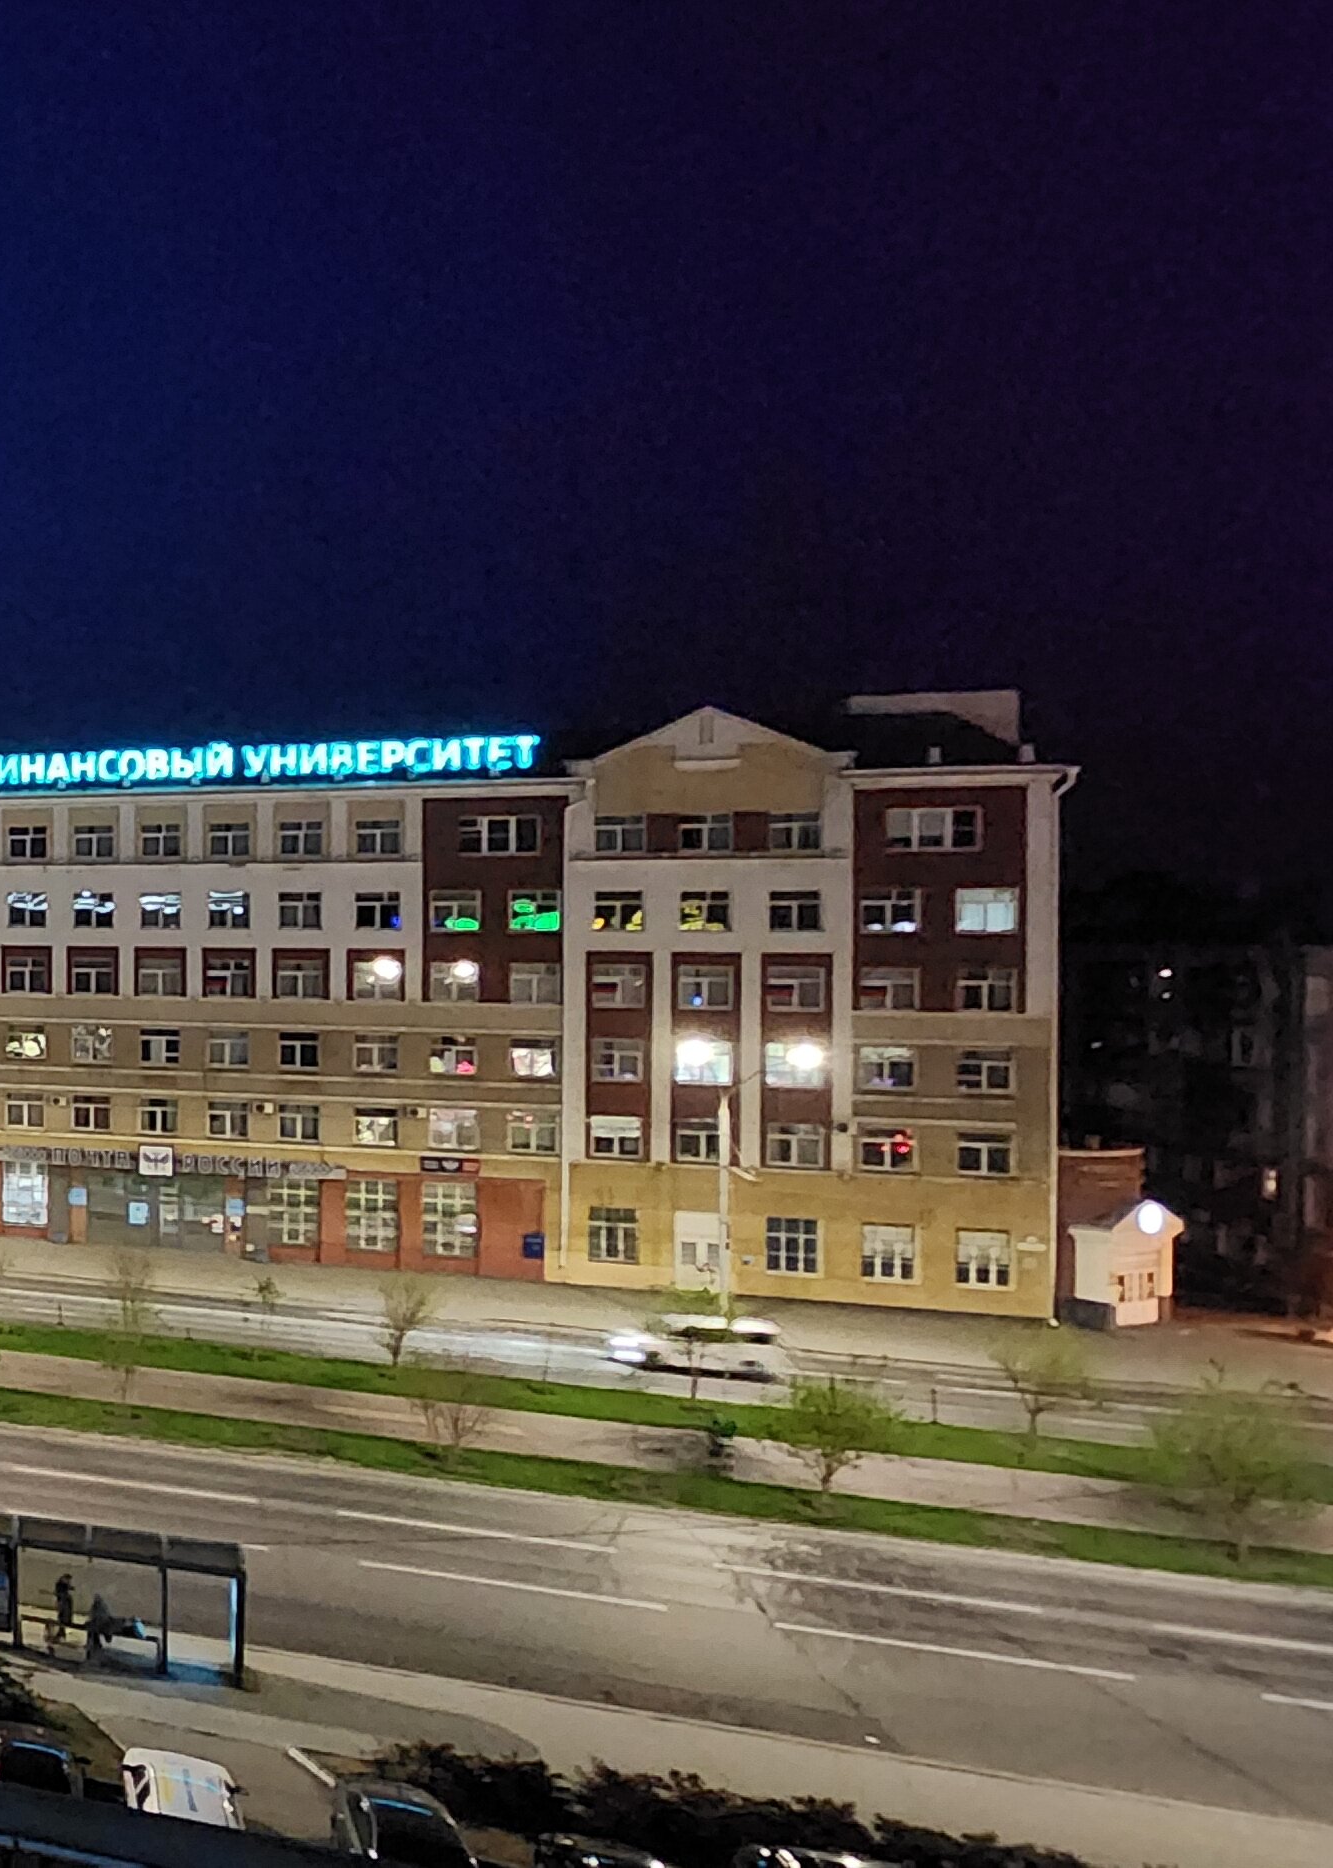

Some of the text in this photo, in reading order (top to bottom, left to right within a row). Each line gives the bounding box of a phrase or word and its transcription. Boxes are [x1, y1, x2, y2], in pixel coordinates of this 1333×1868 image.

[241, 735, 540, 777] УНИВЕРСИТЕТ
[51, 1147, 282, 1179] ПОЧТА РОССИИ
